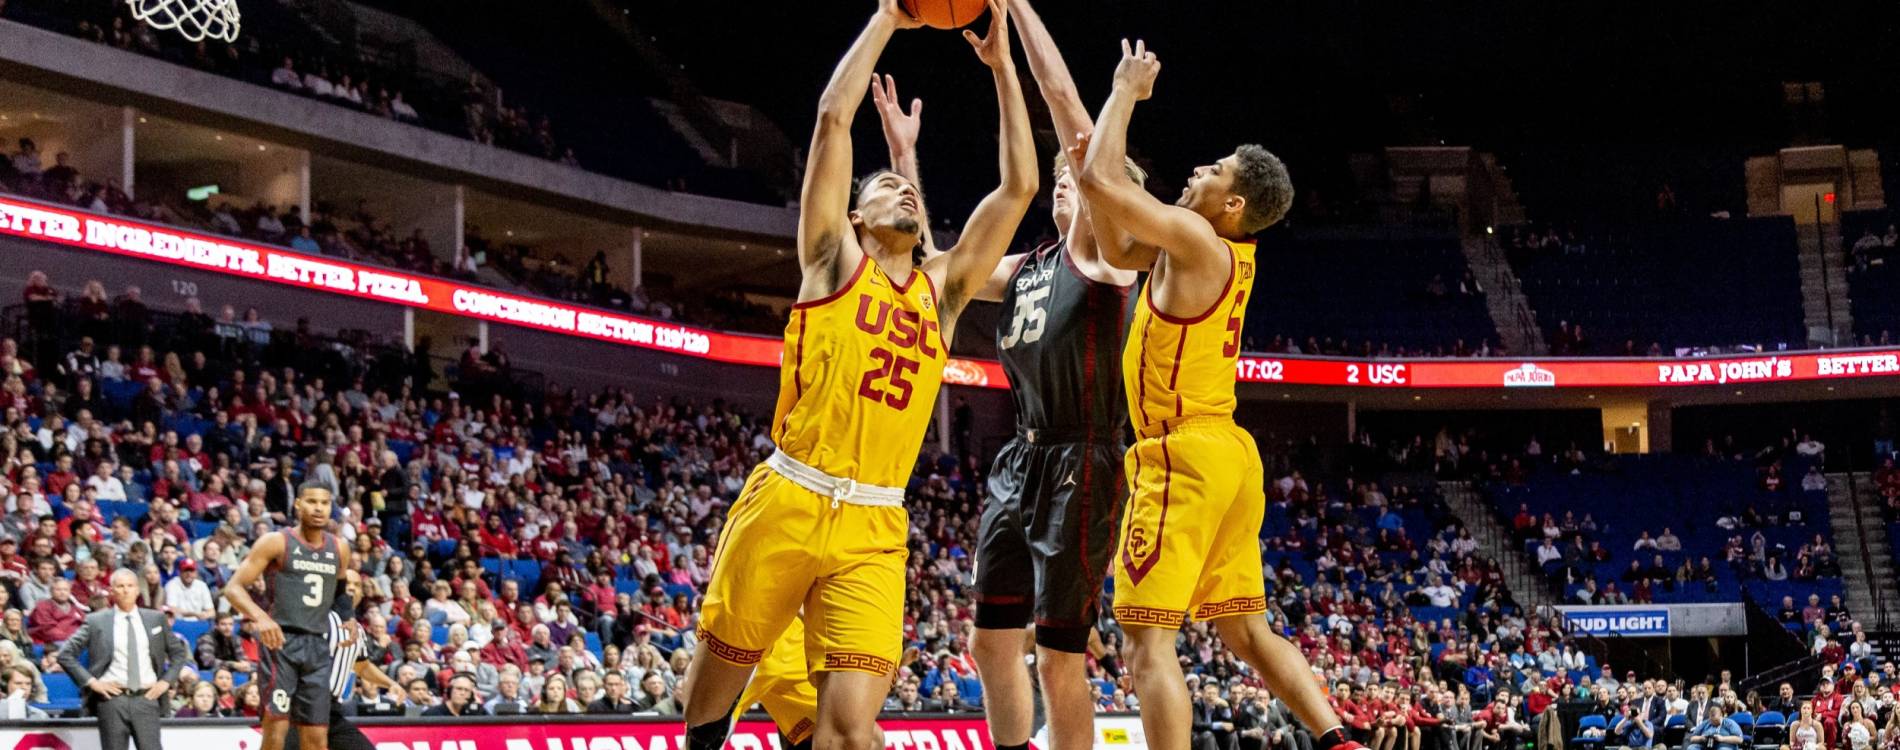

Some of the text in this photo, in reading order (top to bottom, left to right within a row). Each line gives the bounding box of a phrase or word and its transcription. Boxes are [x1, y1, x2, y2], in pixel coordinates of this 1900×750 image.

[0, 202, 430, 304] ETTER INGREDIENTS. BETTER PIZZA.
[171, 279, 198, 296] 120
[452, 288, 577, 332] CONCESSION
[577, 311, 654, 345] SECTION
[855, 293, 938, 360] USC
[1001, 285, 1051, 351] 35
[1222, 290, 1246, 358] 5
[858, 346, 920, 411] 25
[1346, 363, 1406, 384] 2 USC
[1658, 354, 1900, 384] PAPA JOHN'S BETTER
[302, 573, 324, 608] 3
[1609, 615, 1666, 631] LIGHT
